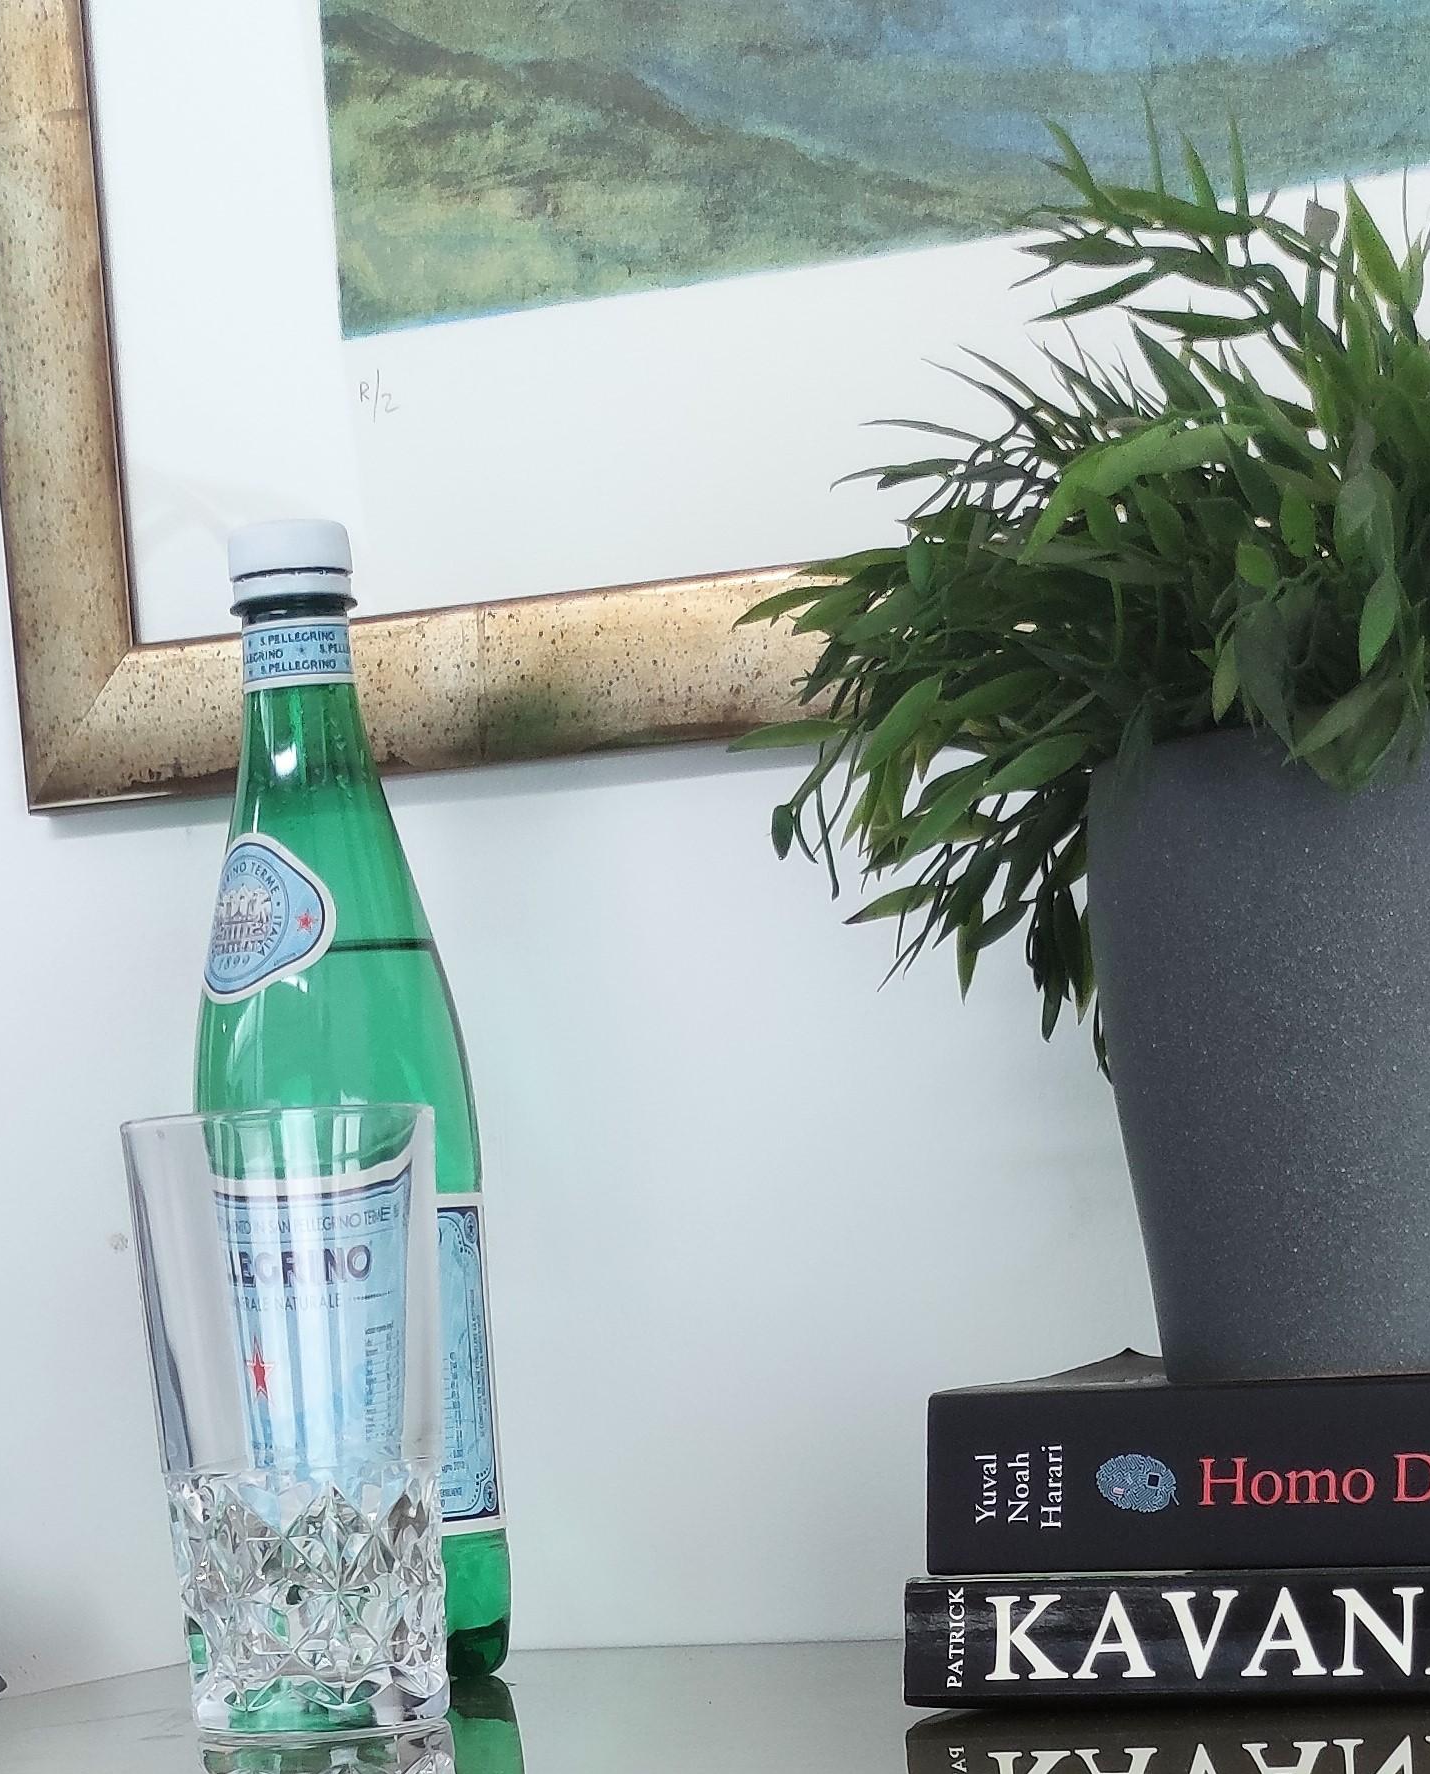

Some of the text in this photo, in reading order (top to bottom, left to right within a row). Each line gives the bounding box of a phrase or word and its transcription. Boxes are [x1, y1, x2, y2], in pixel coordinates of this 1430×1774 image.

[251, 862, 280, 895] TERME
[975, 1453, 998, 1524] Yuval
[1007, 1452, 1030, 1524] Noah
[1040, 1444, 1063, 1529] Harari
[1198, 1456, 1375, 1506] Homo
[946, 1587, 965, 1689] PATRICK
